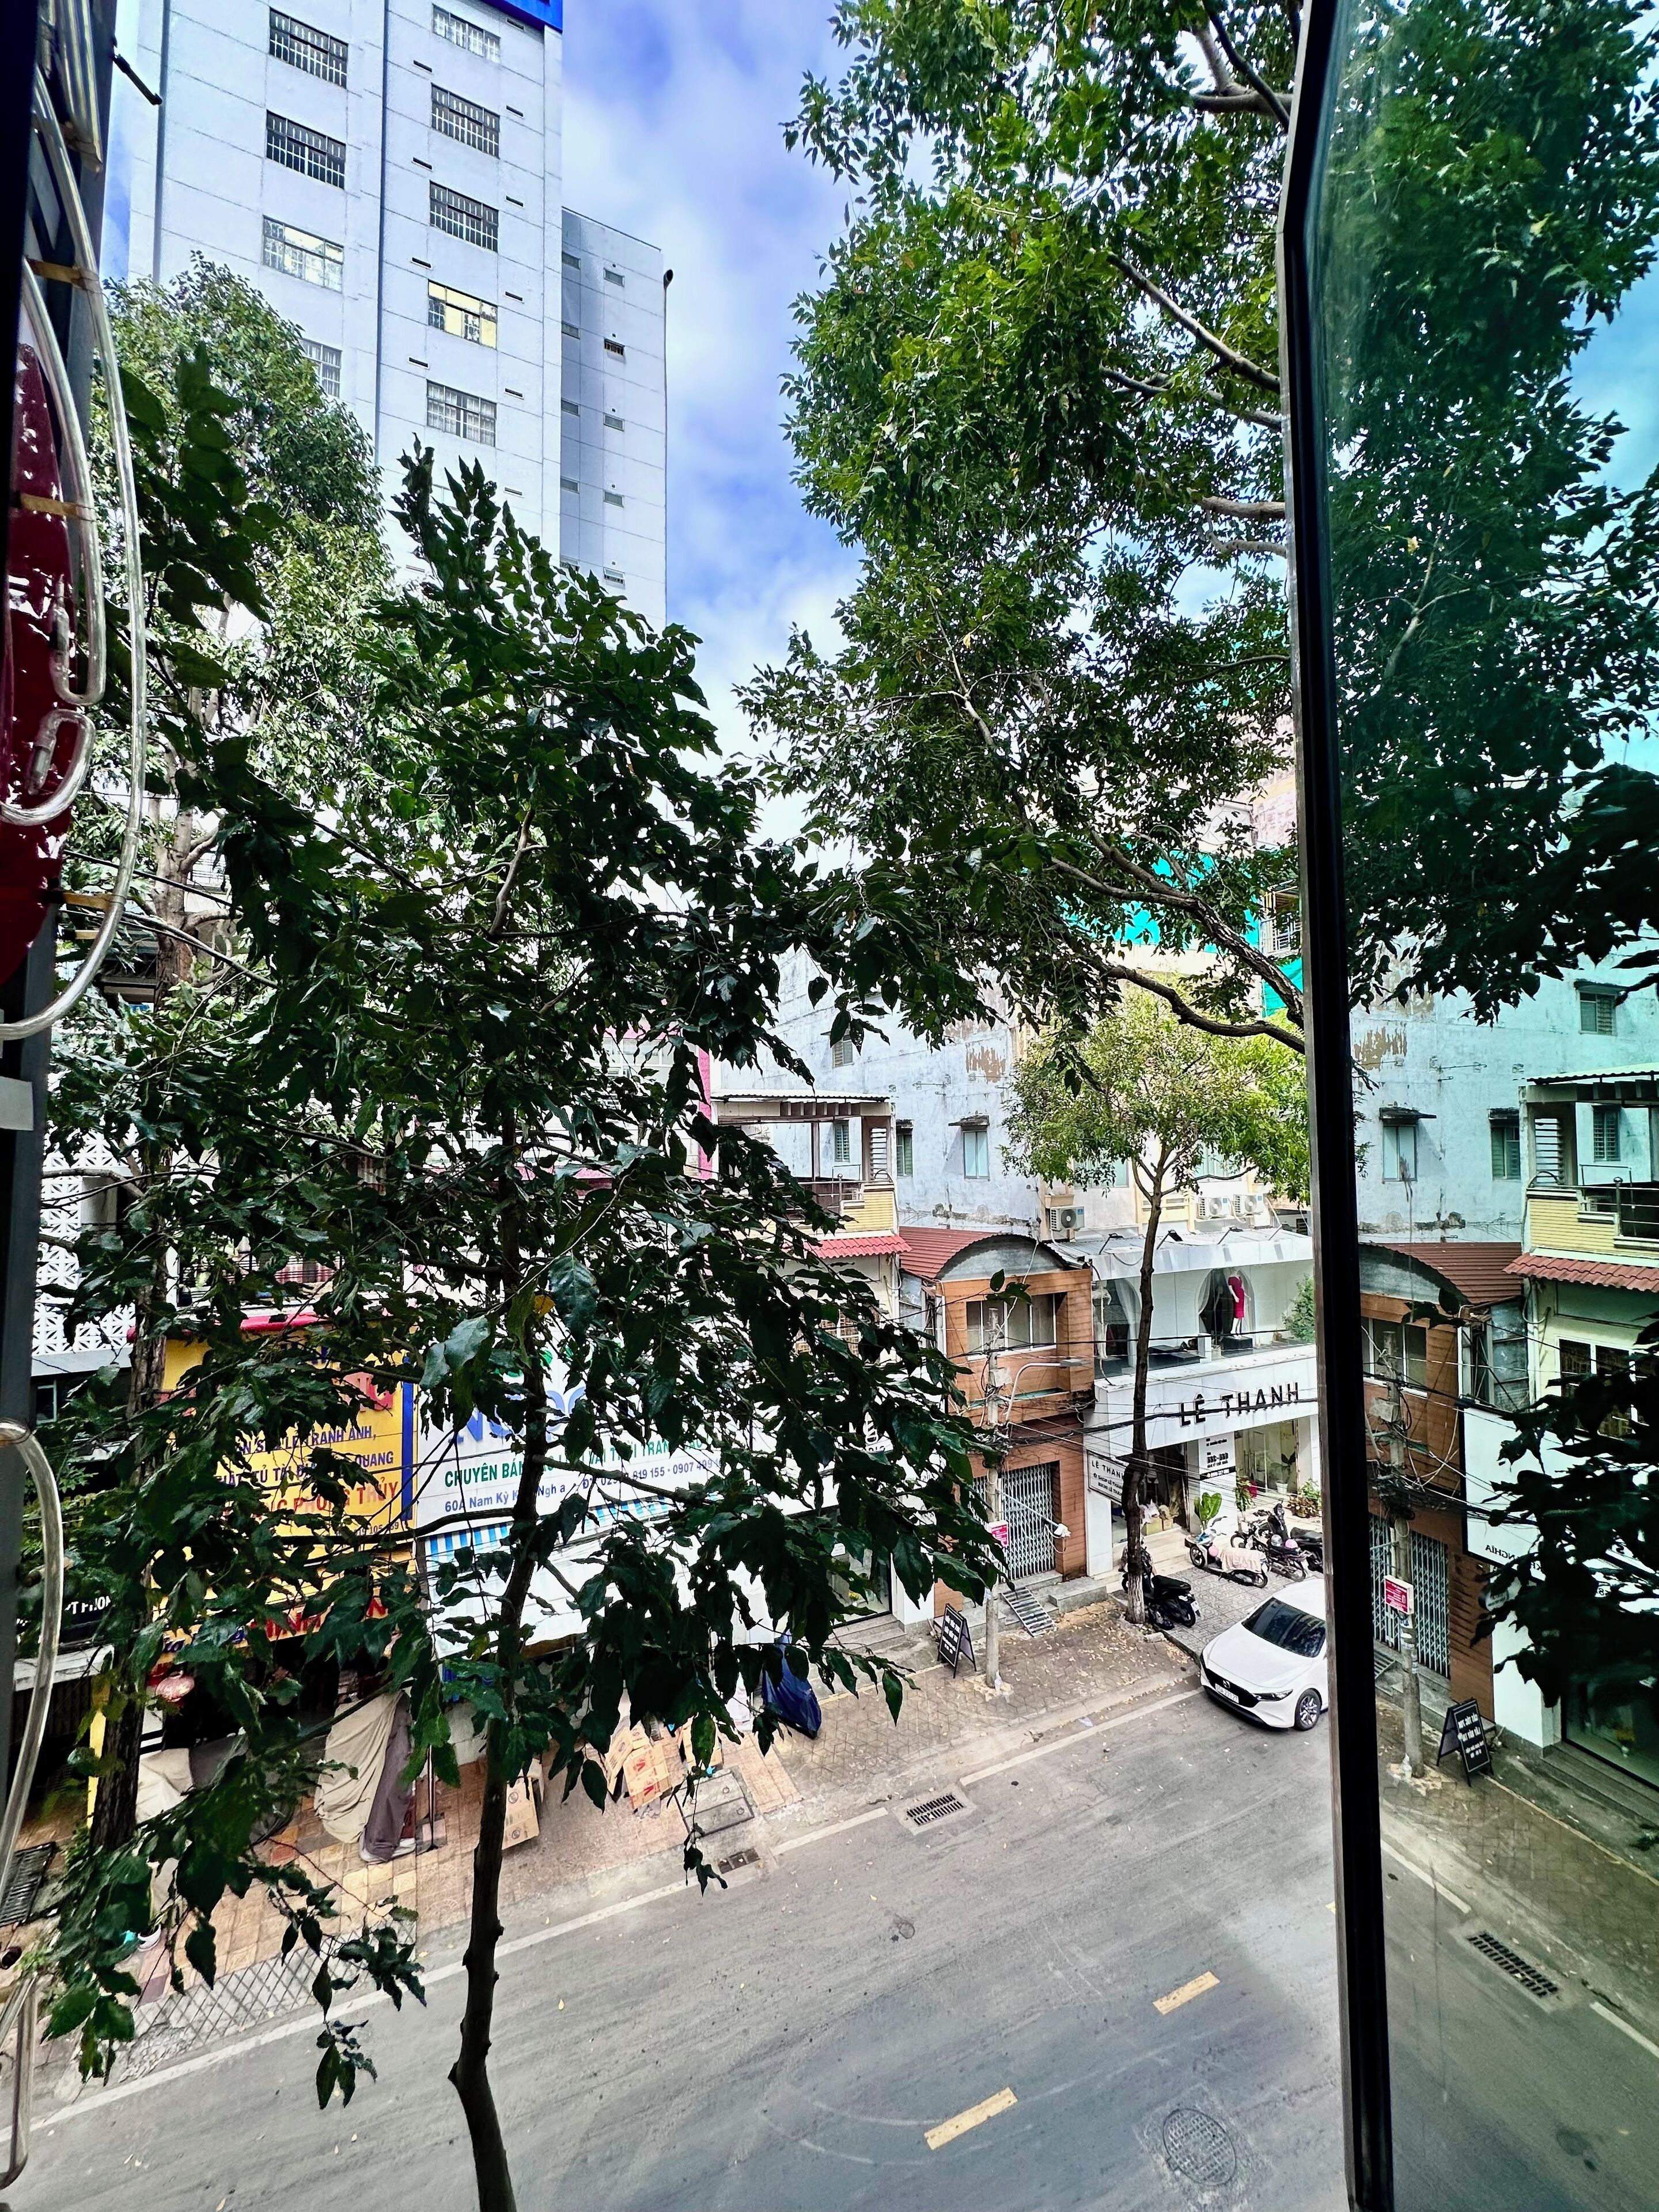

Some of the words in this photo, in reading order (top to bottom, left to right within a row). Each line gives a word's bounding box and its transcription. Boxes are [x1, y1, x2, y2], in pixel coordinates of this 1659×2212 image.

[1180, 1393, 1206, 1426] LÊ
[1221, 1382, 1298, 1418] THANH
[445, 1462, 498, 1487] CHUYÊN
[640, 1439, 670, 1457] TRAN
[445, 1499, 465, 1512] 60A
[469, 1494, 493, 1509] Nam
[496, 1491, 509, 1505] Kỳ
[537, 1483, 566, 1498] Ngha
[650, 1466, 665, 1479] 155
[673, 1461, 694, 1475] 0907
